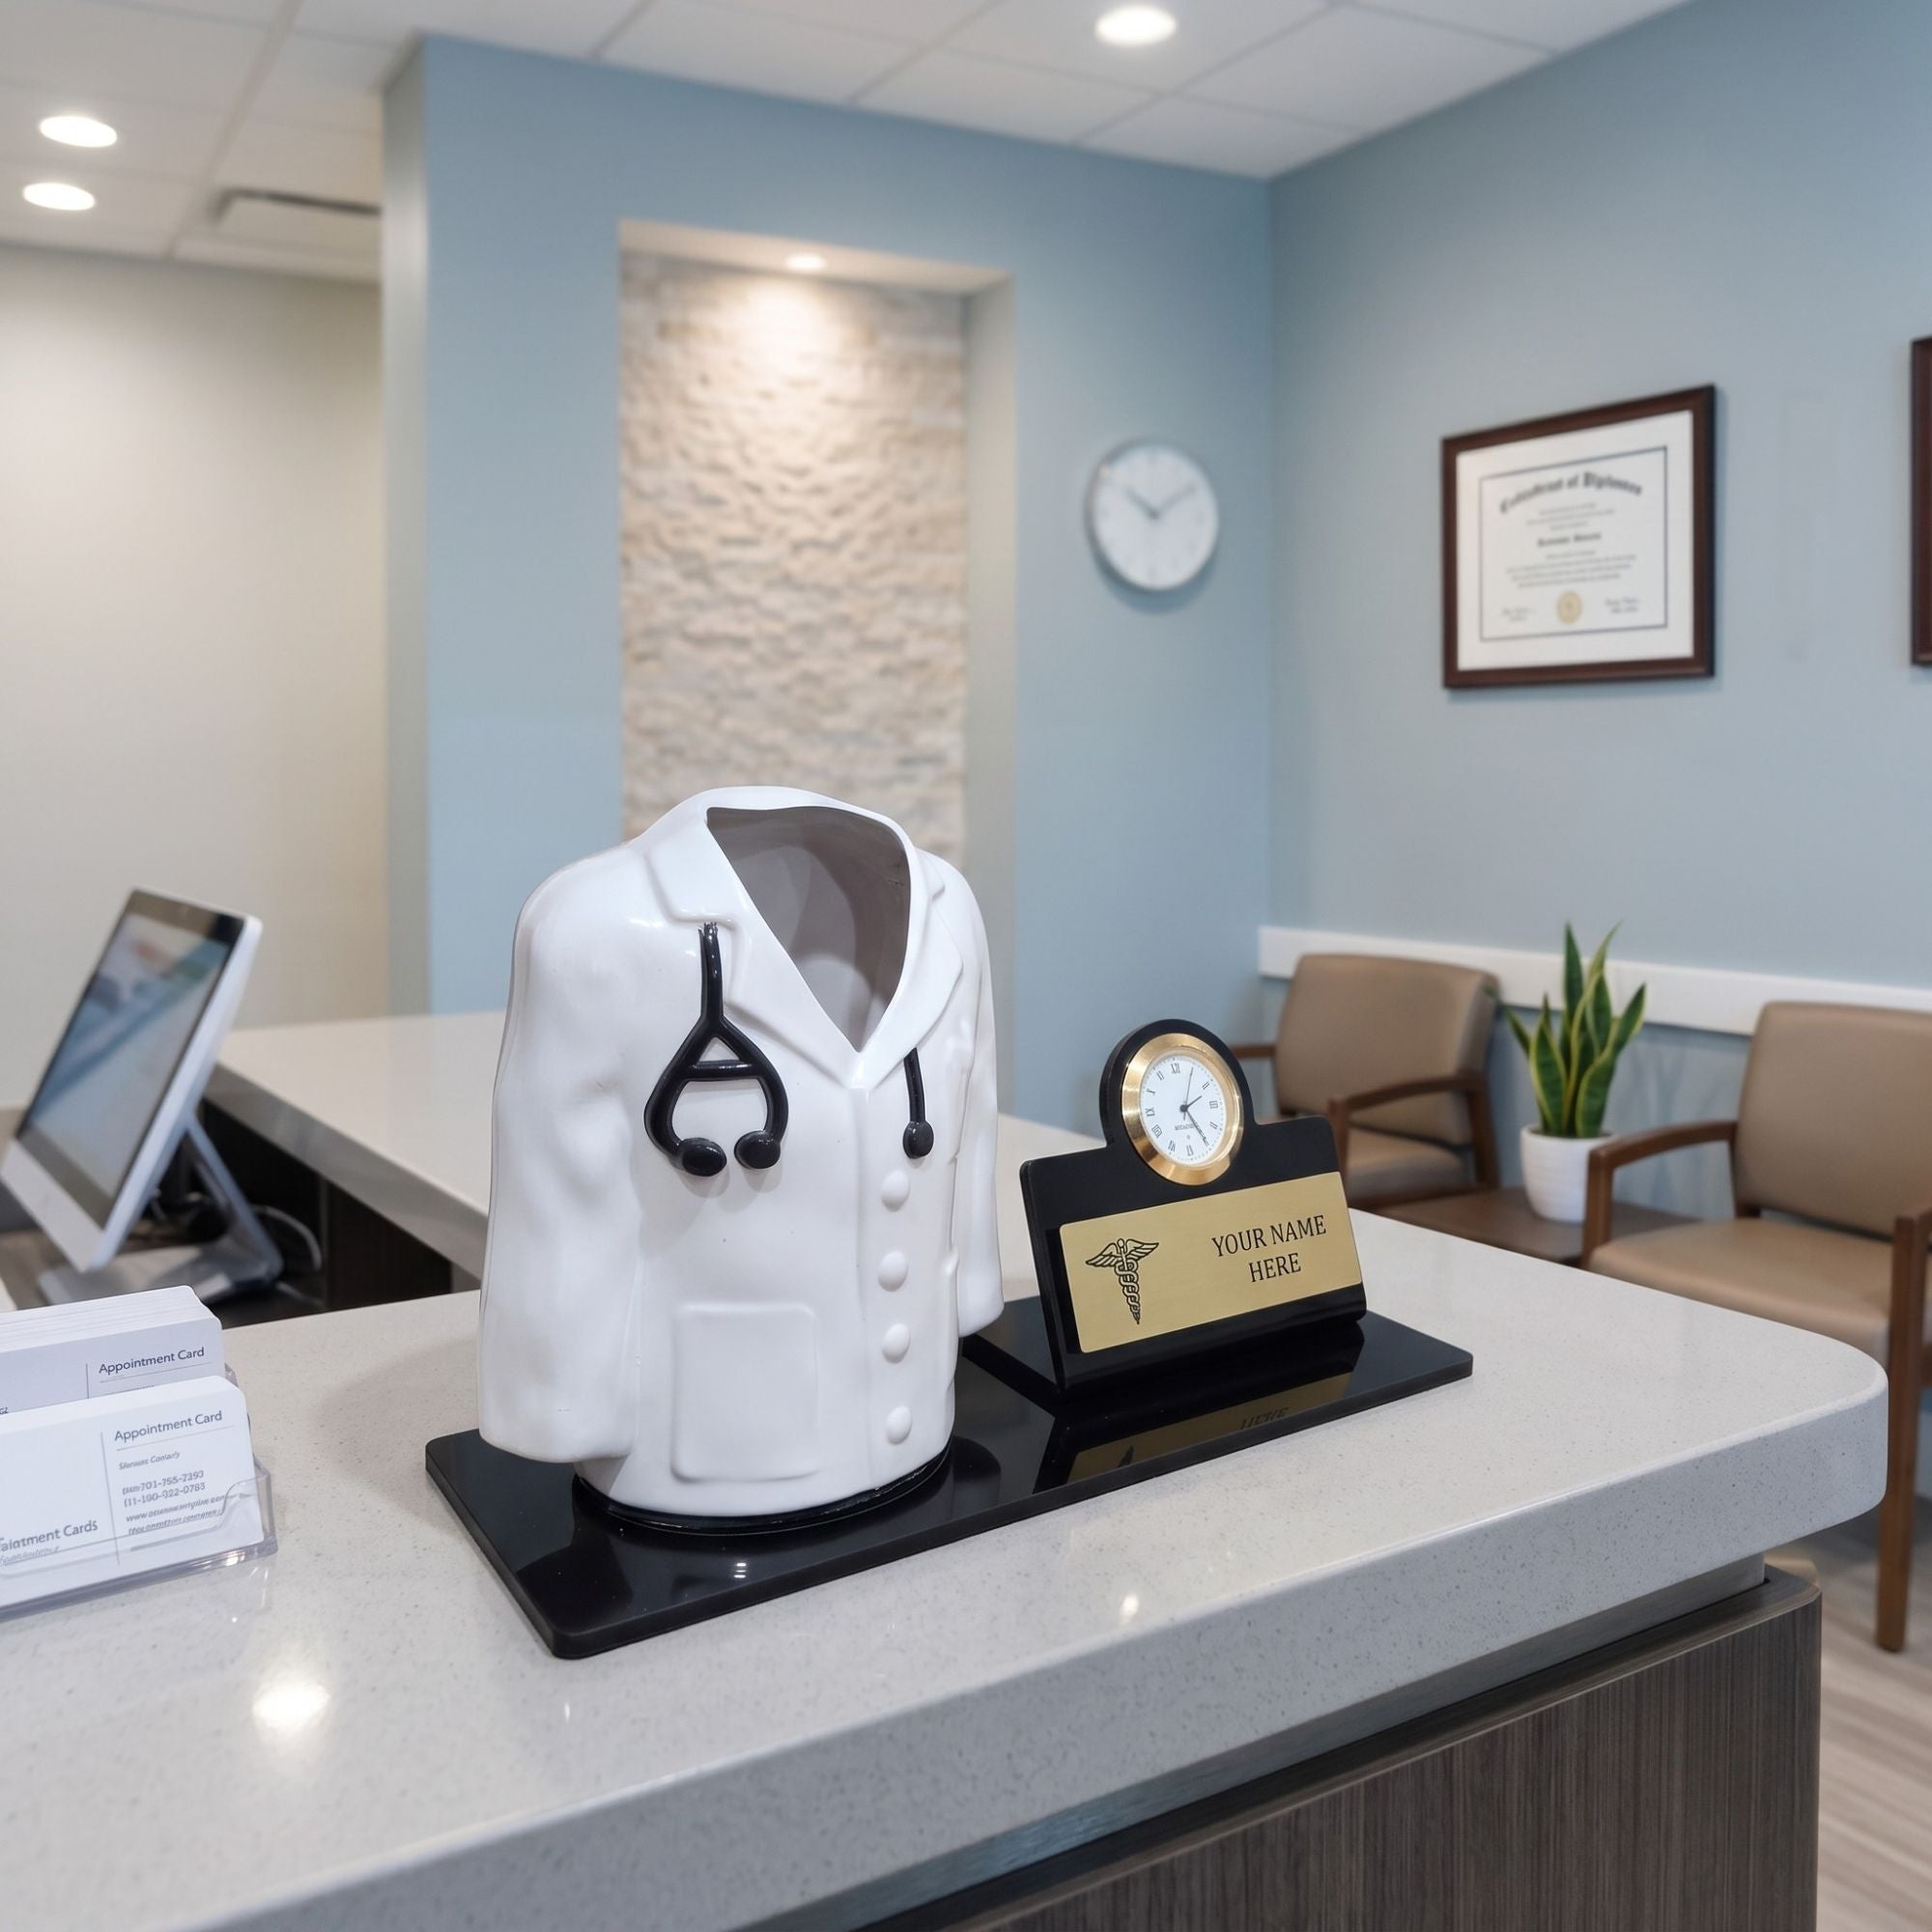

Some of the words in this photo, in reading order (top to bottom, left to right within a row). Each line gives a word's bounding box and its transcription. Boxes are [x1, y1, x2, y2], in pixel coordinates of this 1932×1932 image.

[1211, 1228, 1267, 1258] YOUR
[1269, 1215, 1326, 1245] NAME
[1249, 1253, 1301, 1283] HERE
[99, 1352, 175, 1376] Appointment
[178, 1347, 205, 1360] Card
[114, 1417, 192, 1443] Appointment
[194, 1410, 223, 1426] Card
[63, 1520, 99, 1537] Cards
